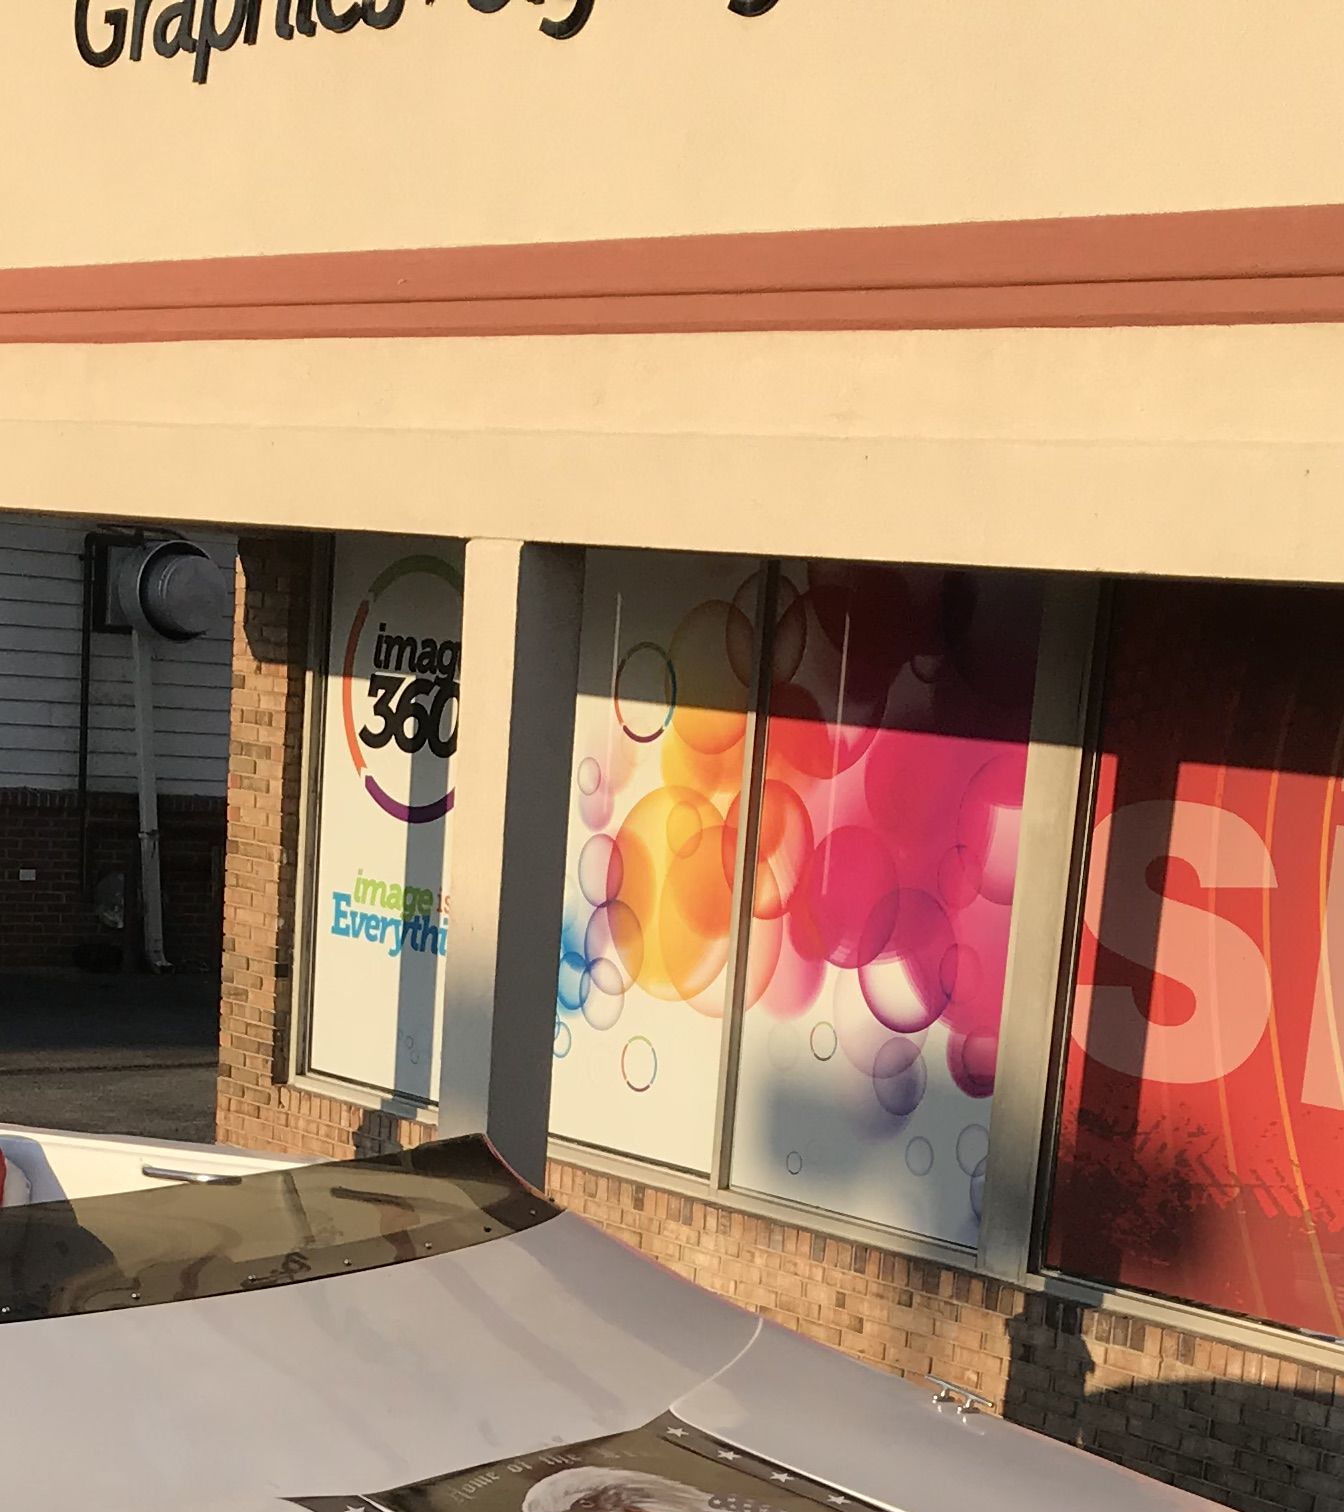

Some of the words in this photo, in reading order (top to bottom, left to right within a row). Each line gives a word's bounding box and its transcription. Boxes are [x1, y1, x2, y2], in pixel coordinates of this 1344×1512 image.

[374, 622, 462, 682] imag
[358, 673, 460, 759] 360
[331, 891, 448, 957] Everythi
[354, 868, 433, 921] image
